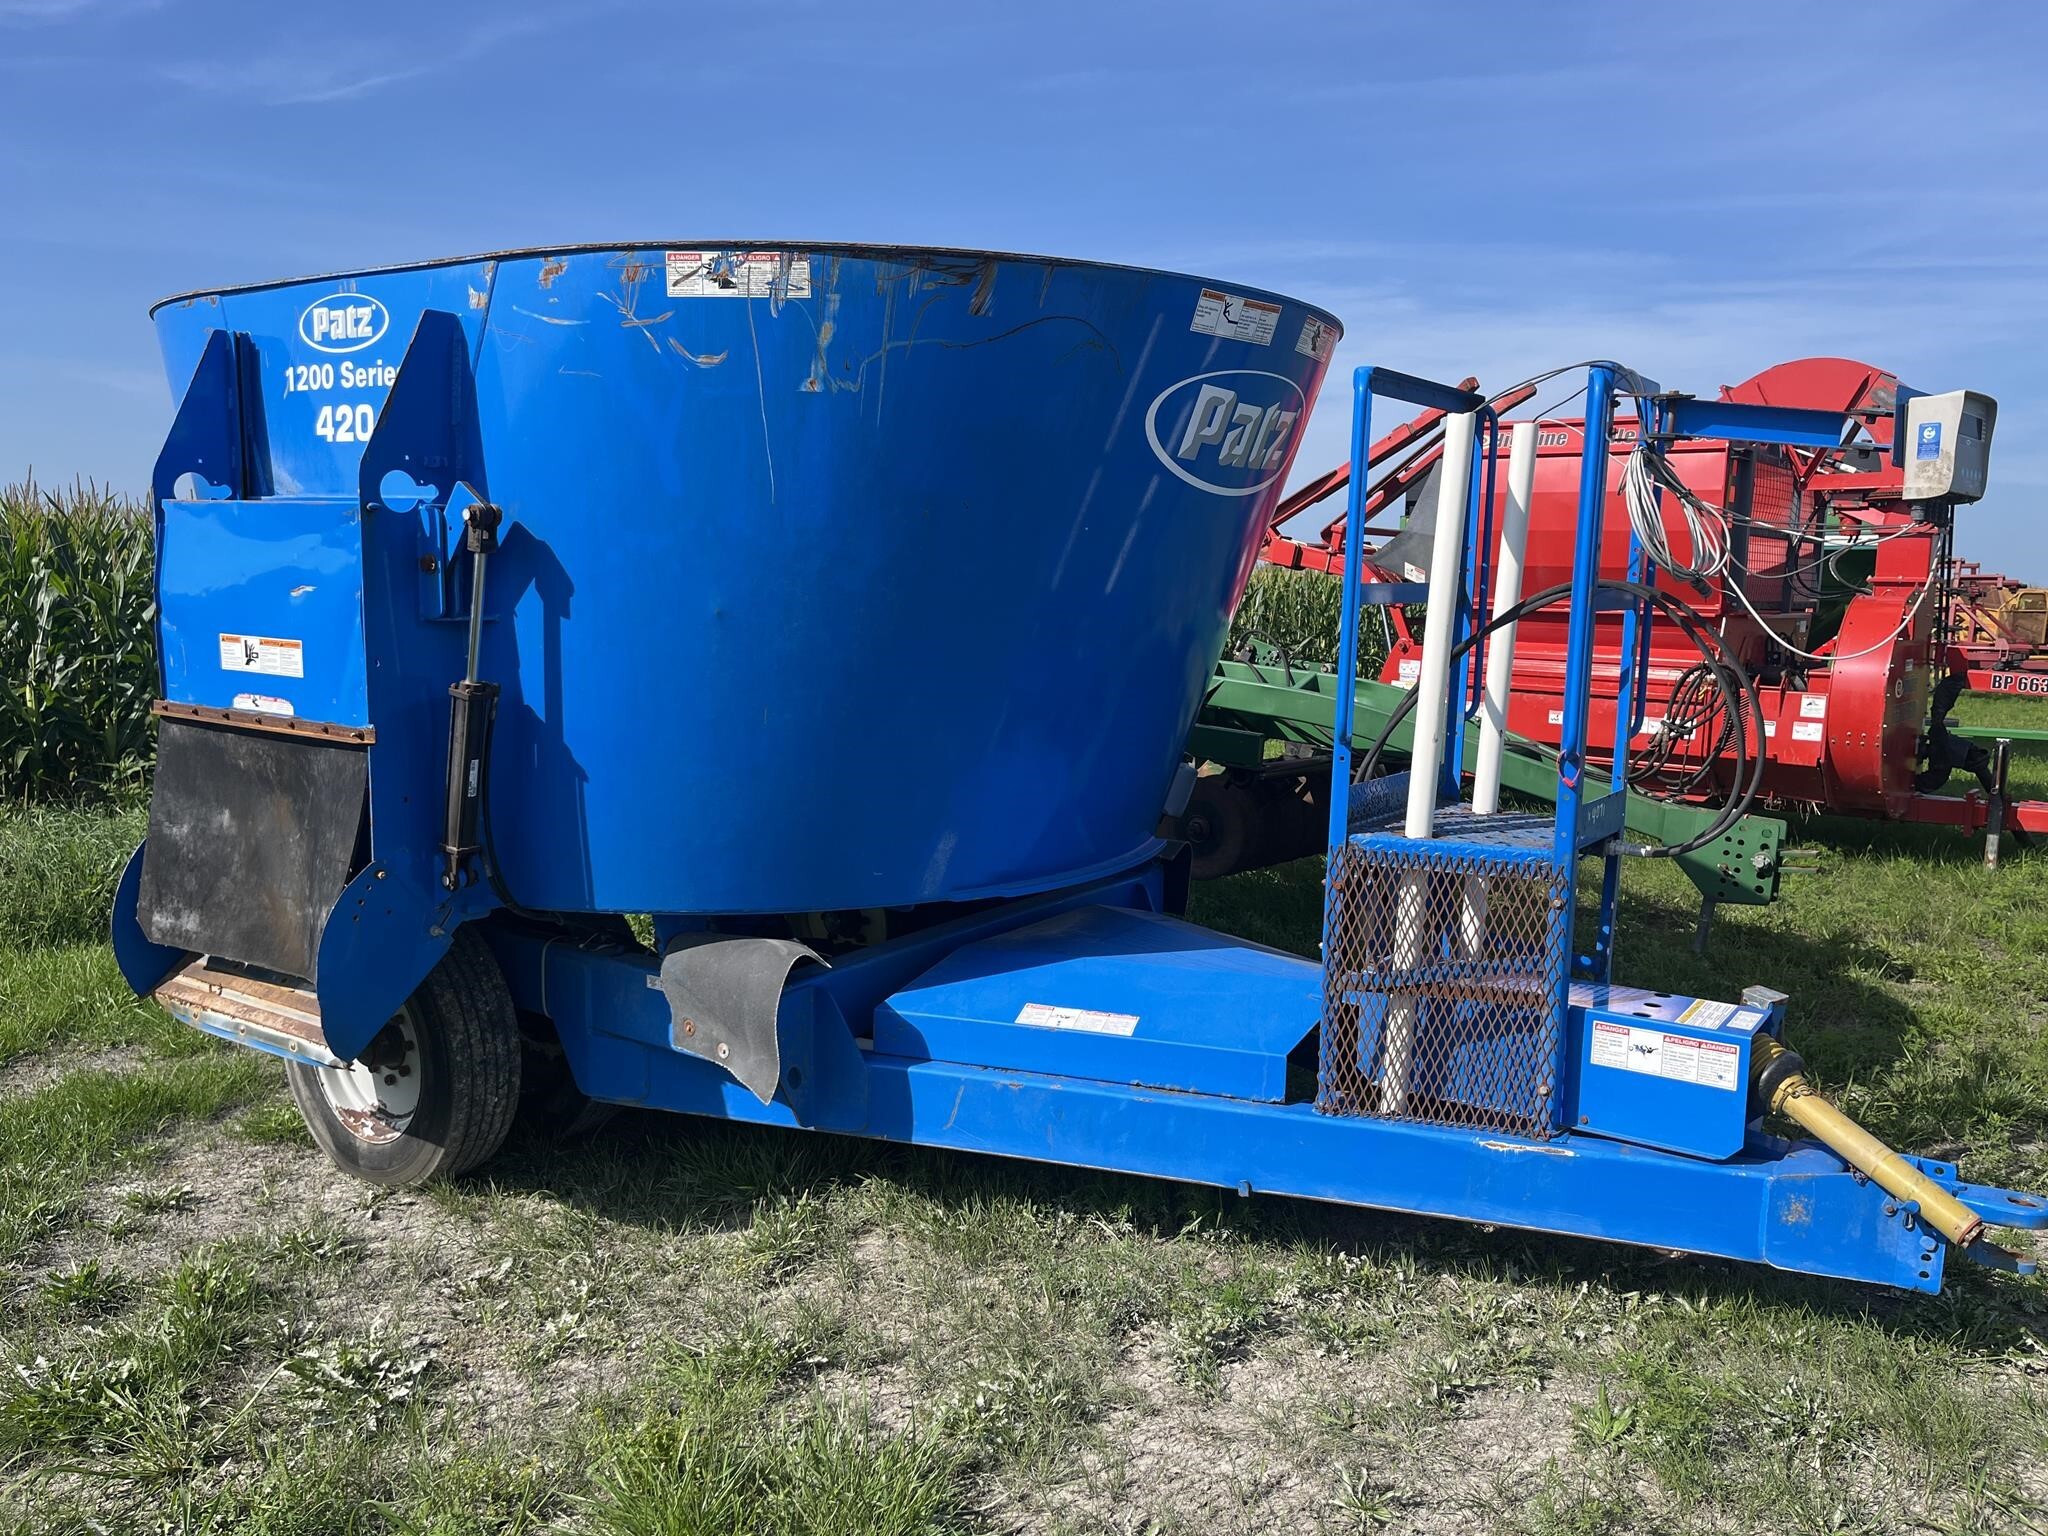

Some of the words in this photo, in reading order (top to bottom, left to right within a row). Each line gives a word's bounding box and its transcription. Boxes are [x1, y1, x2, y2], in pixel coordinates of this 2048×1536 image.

[675, 253, 700, 261] DANGER
[312, 304, 373, 342] Patz
[285, 363, 334, 392] 1200
[340, 359, 400, 388] Serie
[316, 403, 374, 442] 420
[1177, 383, 1297, 470] Patz
[1991, 673, 2014, 690] BP
[2017, 676, 2048, 693] 663
[1601, 1024, 1628, 1035] DANGER
[1668, 1036, 1699, 1047] PELIGRO
[1705, 1043, 1737, 1055] DANGER
